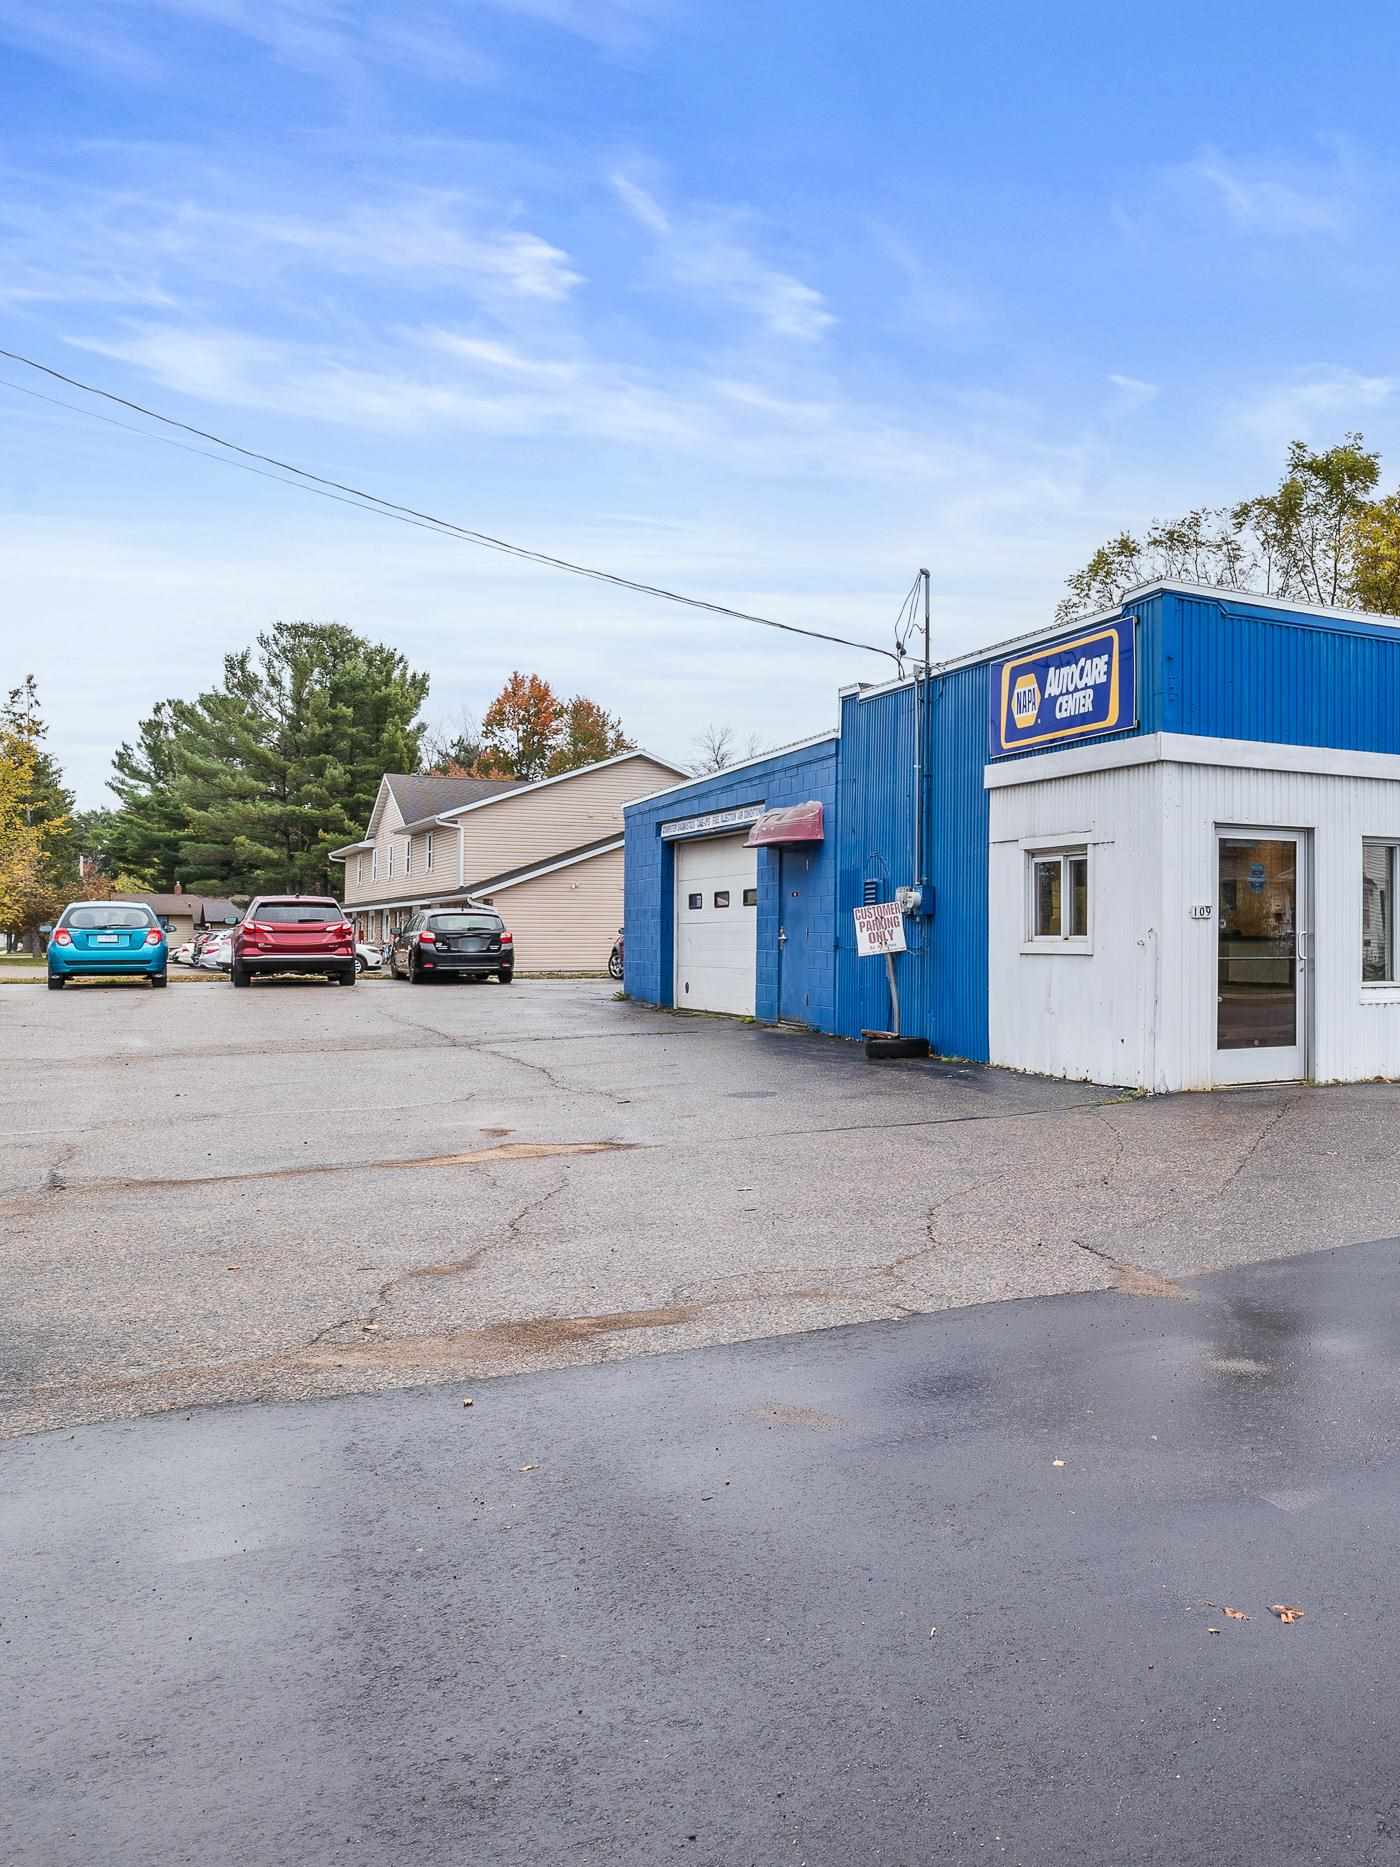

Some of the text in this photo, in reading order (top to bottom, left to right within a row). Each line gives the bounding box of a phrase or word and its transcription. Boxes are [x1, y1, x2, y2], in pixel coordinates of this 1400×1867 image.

[1016, 687, 1037, 714] NAPA
[1055, 688, 1094, 719] CENTER
[855, 903, 901, 920] CUSTOMER
[1194, 906, 1211, 917] 109
[859, 916, 900, 933] PARKING
[868, 929, 894, 944] ONLY
